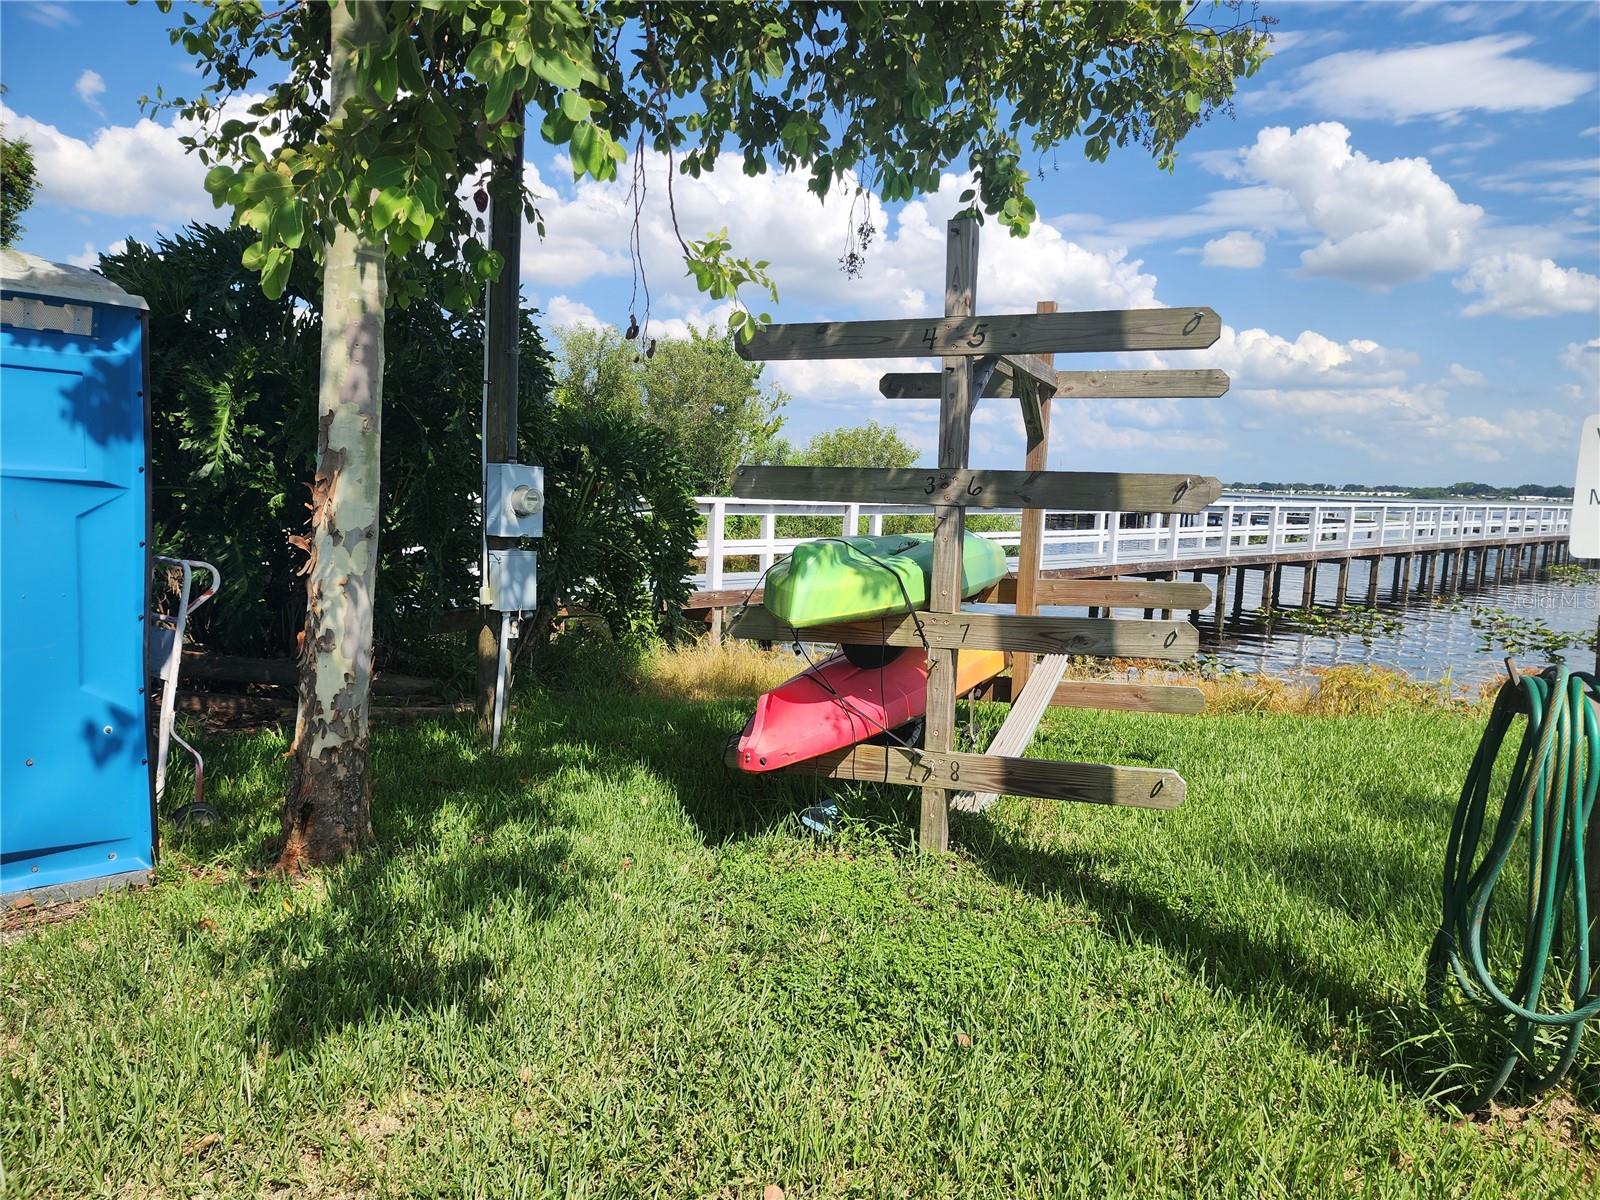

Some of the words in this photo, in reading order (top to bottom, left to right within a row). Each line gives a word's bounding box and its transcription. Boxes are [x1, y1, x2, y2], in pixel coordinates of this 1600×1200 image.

[922, 327, 938, 350] 4
[966, 323, 989, 348] 5
[924, 476, 936, 495] 3
[967, 475, 983, 496] 6
[960, 623, 970, 643] 7
[950, 760, 960, 782] 8
